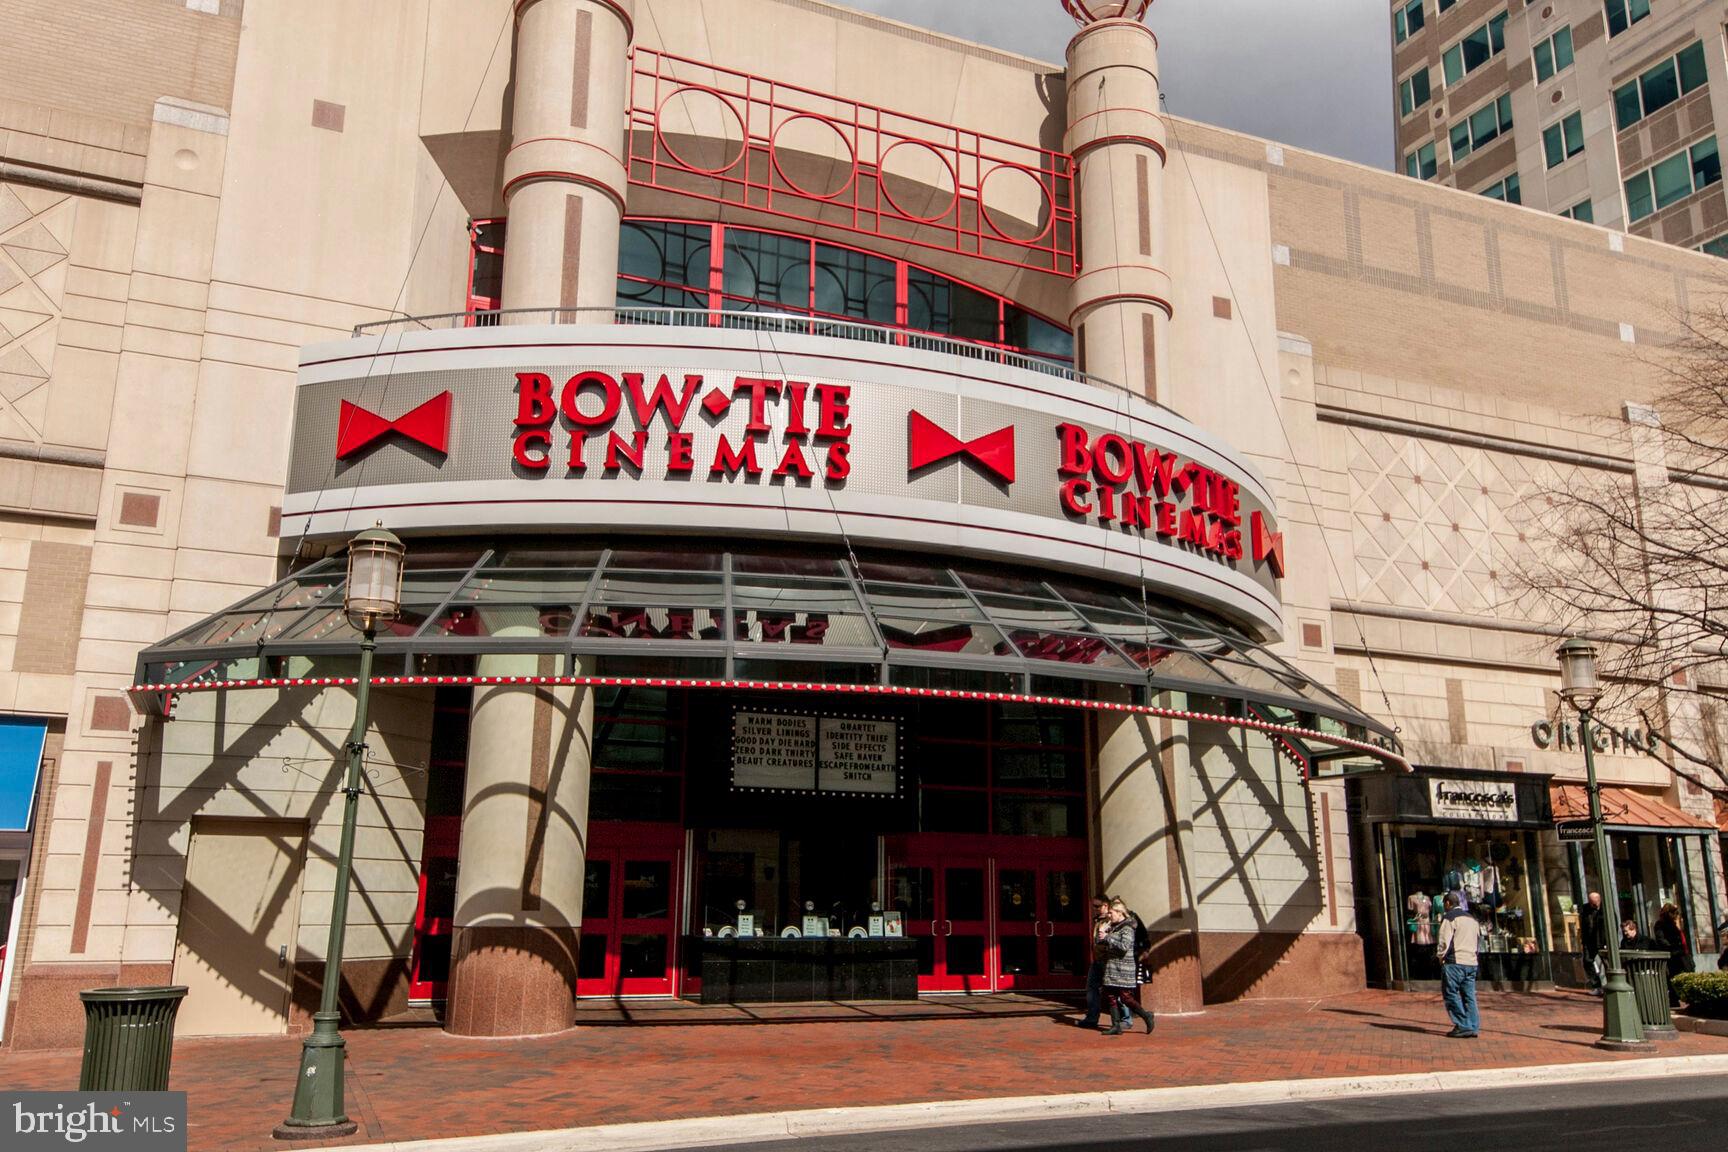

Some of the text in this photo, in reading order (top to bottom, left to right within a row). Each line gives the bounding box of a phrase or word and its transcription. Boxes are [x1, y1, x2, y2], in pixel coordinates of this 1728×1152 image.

[513, 371, 852, 438] BOW TIE
[513, 430, 851, 480] CINEMAS
[1056, 422, 1242, 526] BOW TIE
[1059, 479, 1243, 560] CINEMAS
[748, 717, 807, 728] WARM BODIES
[840, 723, 876, 732] QUARTET
[742, 726, 810, 738] SILVER LININGS
[826, 732, 889, 743] IDENTITY THIEF
[735, 736, 816, 748] GOOD DAY DIE HARD
[832, 742, 887, 752] SIDE EFFECTS
[735, 745, 816, 758] ZERO DARK THIRTY
[834, 751, 882, 762] SAFE HAVEN
[736, 756, 814, 767] BEAUT CREATURES
[844, 771, 872, 781] SNITCH
[1436, 781, 1515, 805] francesca's
